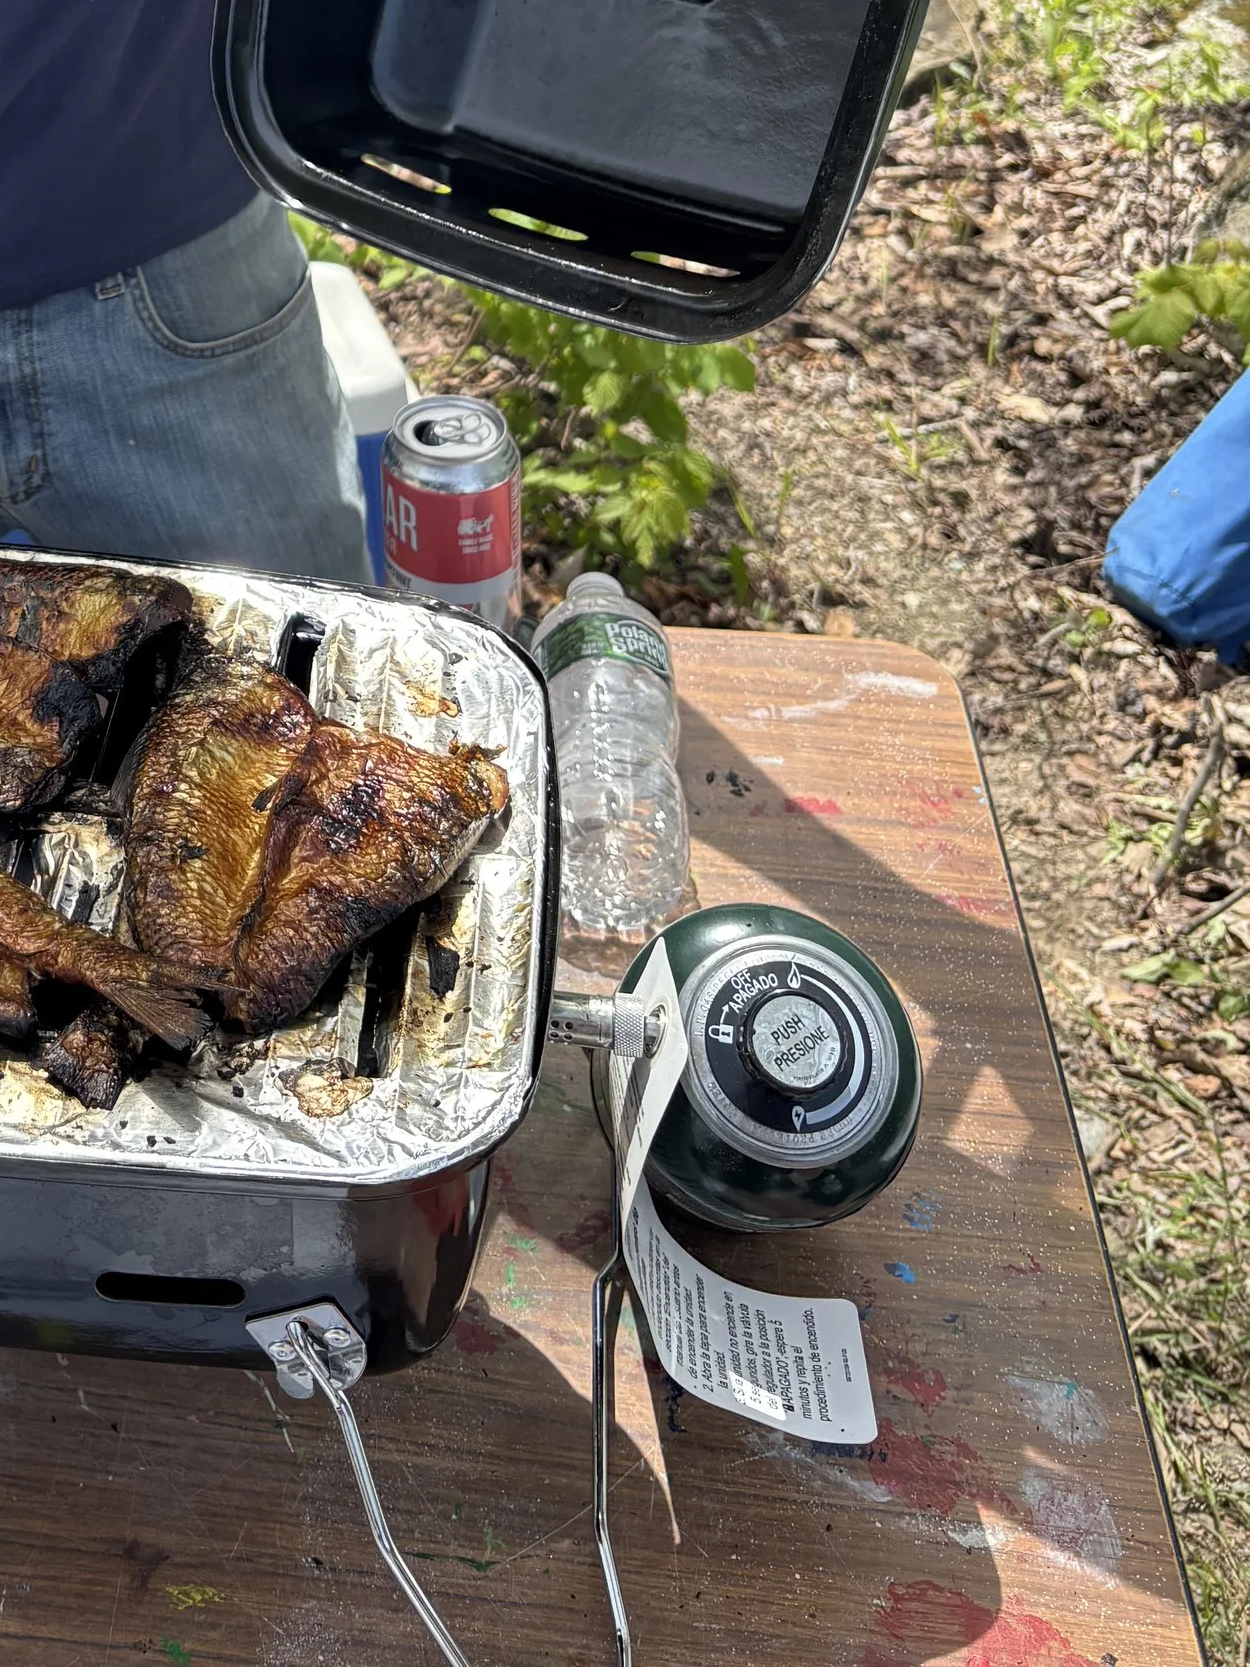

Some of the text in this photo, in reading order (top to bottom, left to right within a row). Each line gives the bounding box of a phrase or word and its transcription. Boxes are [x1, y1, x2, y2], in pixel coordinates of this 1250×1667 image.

[731, 969, 752, 990] OFF
[728, 973, 779, 1014] APAGADO
[771, 1014, 806, 1046] PUSH
[773, 1025, 830, 1072] PRESIONE
[695, 1273, 706, 1313] encender
[724, 1291, 733, 1302] en
[684, 1318, 693, 1327] la
[699, 1313, 710, 1334] para
[724, 1303, 737, 1337] enciende
[738, 1303, 751, 1329] válvula
[754, 1309, 769, 1341] posición
[685, 1327, 696, 1366] encender
[699, 1333, 710, 1352] tapa
[729, 1338, 740, 1350] no
[742, 1331, 753, 1340] la
[700, 1352, 709, 1360] la
[790, 1345, 803, 1354] el
[687, 1368, 698, 1379] de
[701, 1361, 712, 1383] Abra
[729, 1348, 743, 1377] unidad
[793, 1356, 807, 1378] repita
[803, 1307, 832, 1422] procedimiento de encendido.
[717, 1381, 728, 1389] la
[761, 1357, 778, 1395] regulador
[797, 1387, 813, 1420] minutos
